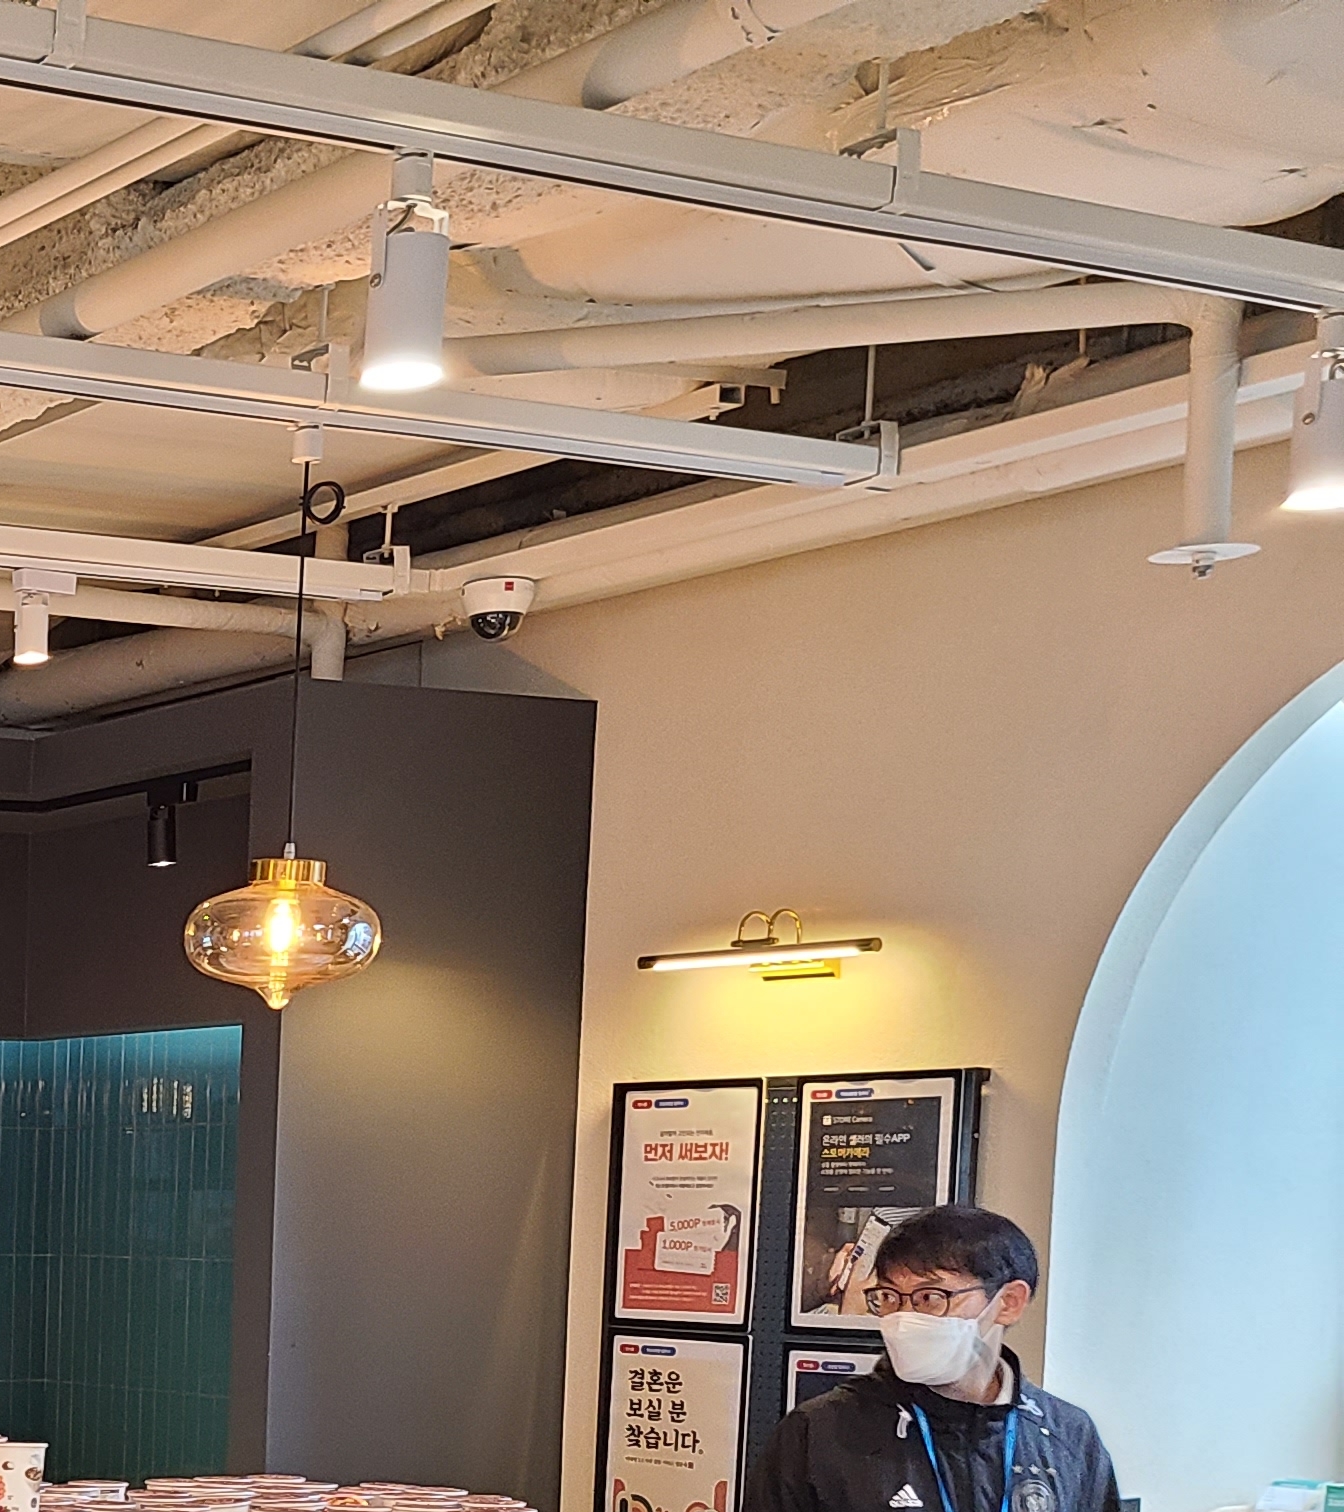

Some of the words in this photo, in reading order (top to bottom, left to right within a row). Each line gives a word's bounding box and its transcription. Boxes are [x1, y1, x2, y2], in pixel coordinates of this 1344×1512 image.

[643, 1143, 674, 1162] 먼저
[678, 1142, 729, 1161] 써보자!
[628, 1368, 683, 1394] 결혼운
[626, 1398, 662, 1421] 보실
[668, 1400, 687, 1423] 분
[625, 1424, 704, 1455] 찾습니다.
